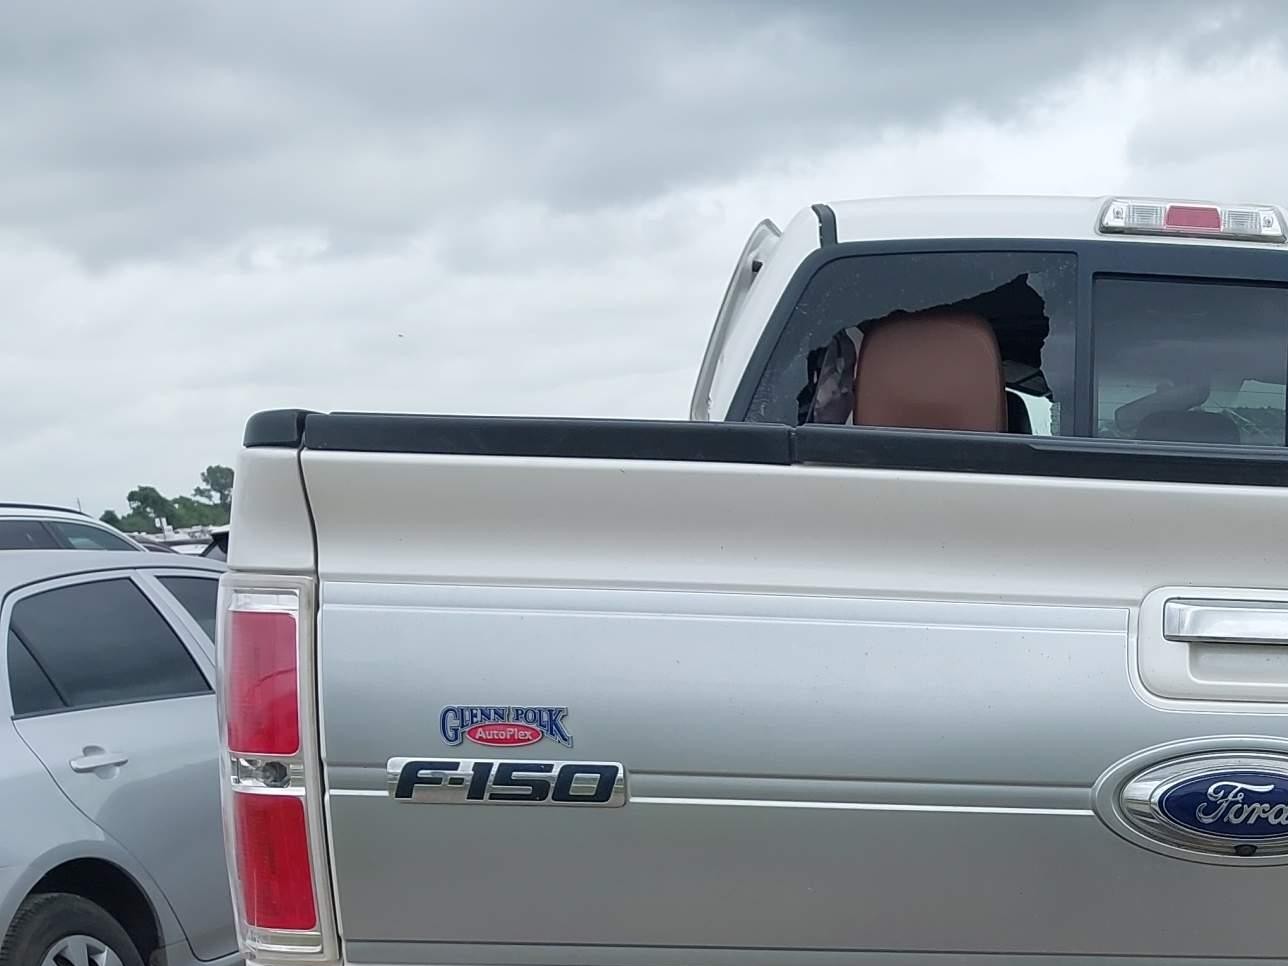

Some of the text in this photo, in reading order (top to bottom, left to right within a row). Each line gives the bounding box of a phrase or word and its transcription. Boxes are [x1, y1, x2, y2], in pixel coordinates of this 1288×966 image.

[441, 706, 570, 746] GLENN POLK
[475, 728, 533, 740] AutoPlex
[394, 761, 620, 803] F-150
